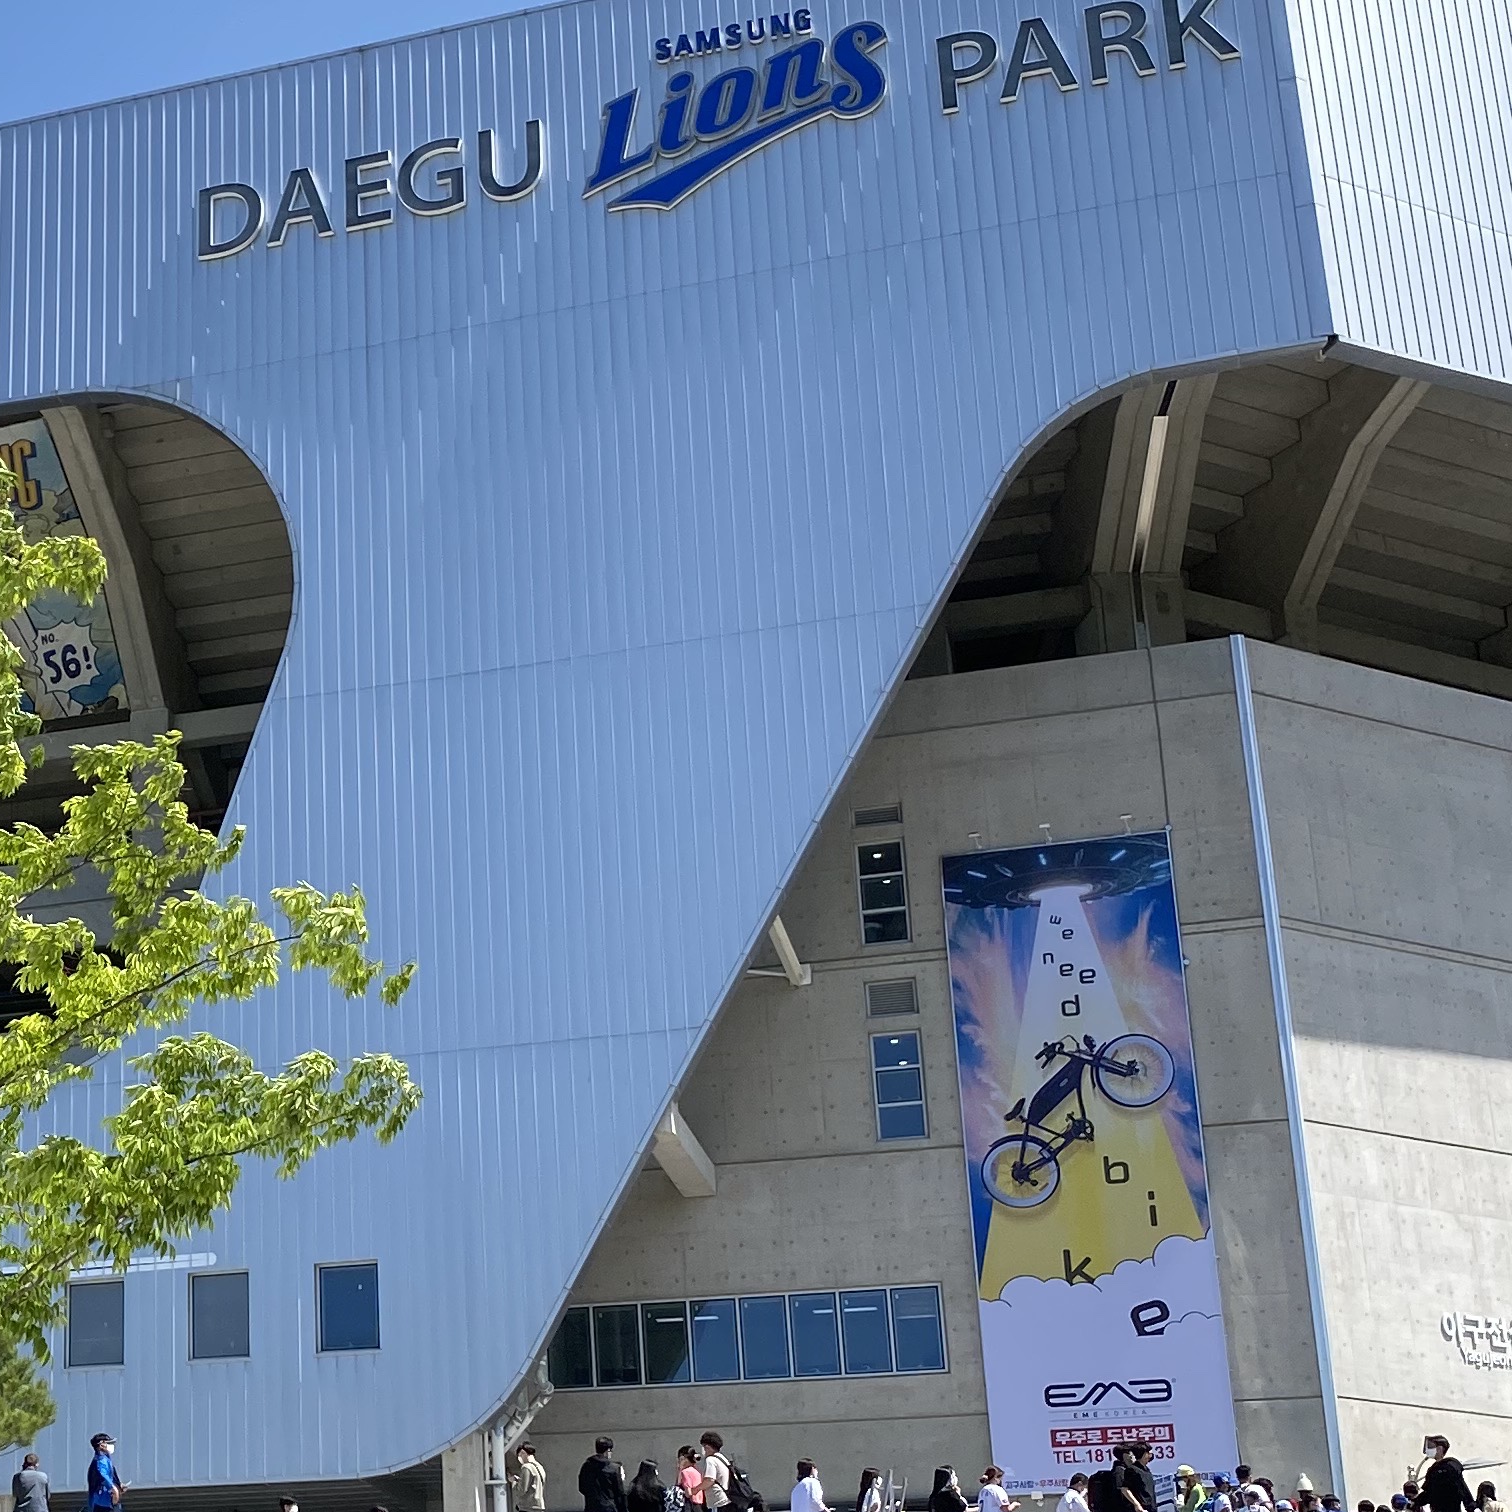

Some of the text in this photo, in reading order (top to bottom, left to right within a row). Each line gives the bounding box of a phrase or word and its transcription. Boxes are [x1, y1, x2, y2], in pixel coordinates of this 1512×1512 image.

[654, 7, 813, 64] SAMSUNG
[934, 0, 1243, 115] PARK
[582, 20, 888, 212] Lions
[198, 118, 544, 261] DAEGU
[42, 643, 93, 684] 56!
[1439, 1310, 1512, 1354] 야구전
[1054, 1425, 1171, 1445] 우주로 도난주의
[1104, 1408, 1148, 1418] KOREA
